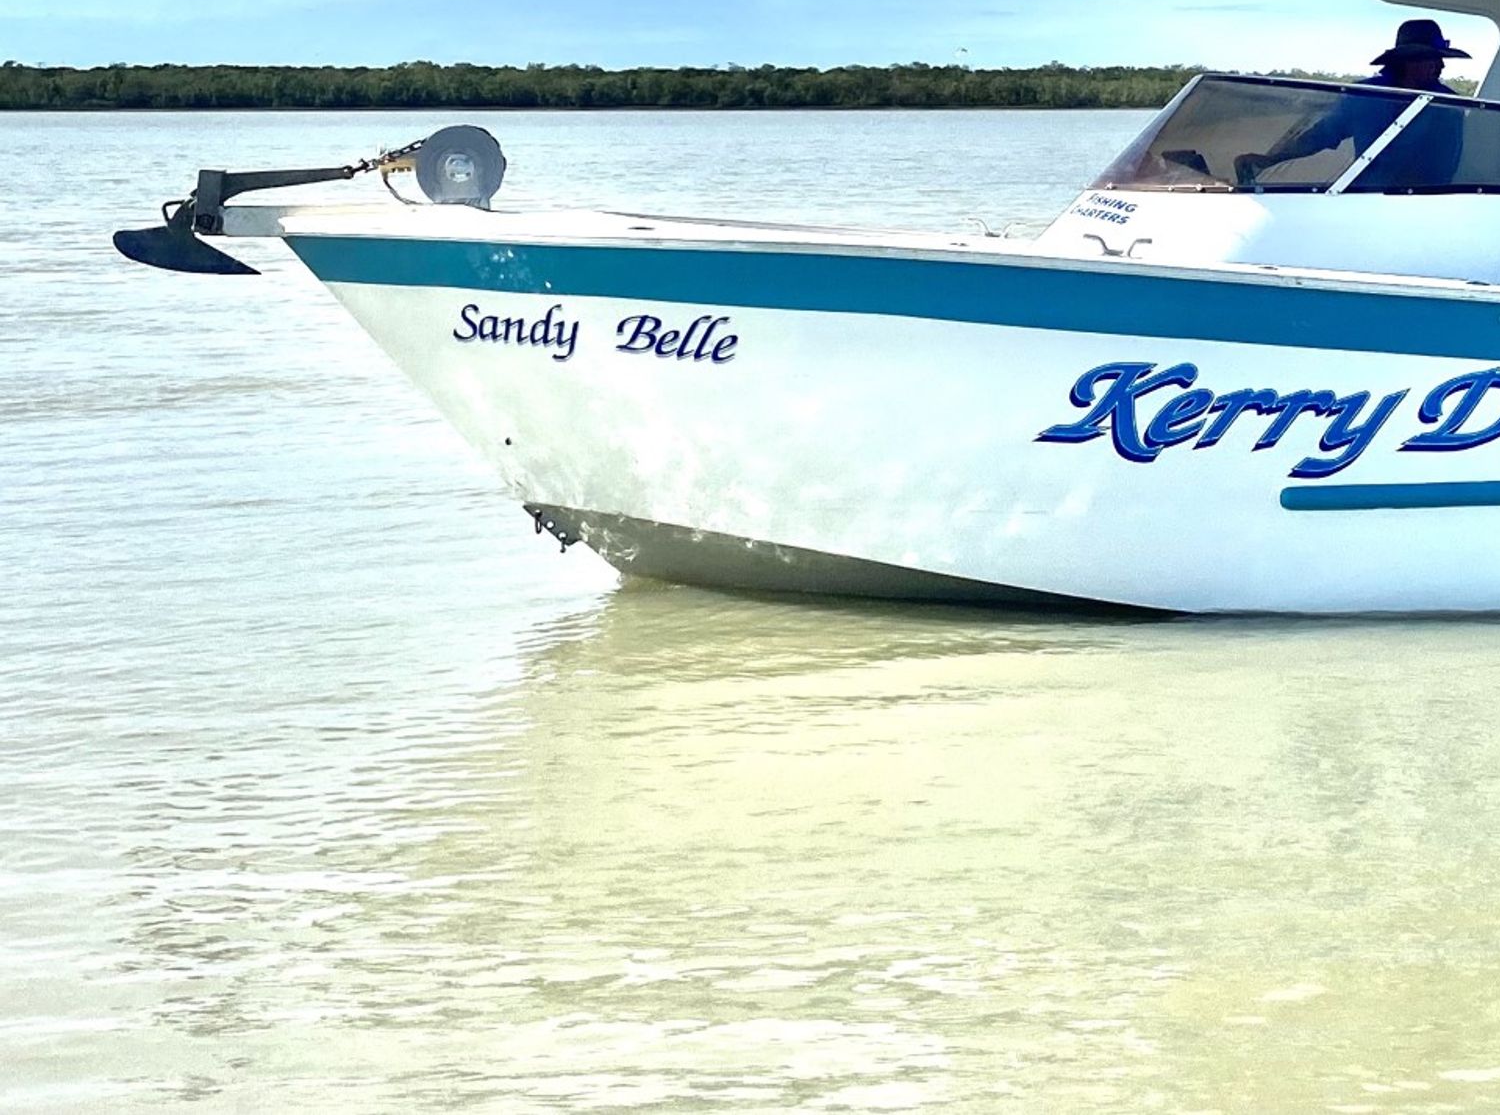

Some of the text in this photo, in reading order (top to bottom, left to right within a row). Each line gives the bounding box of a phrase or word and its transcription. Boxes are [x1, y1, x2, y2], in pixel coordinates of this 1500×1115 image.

[453, 303, 739, 364] Sandy Belle
[1032, 361, 1412, 479] Kerry
